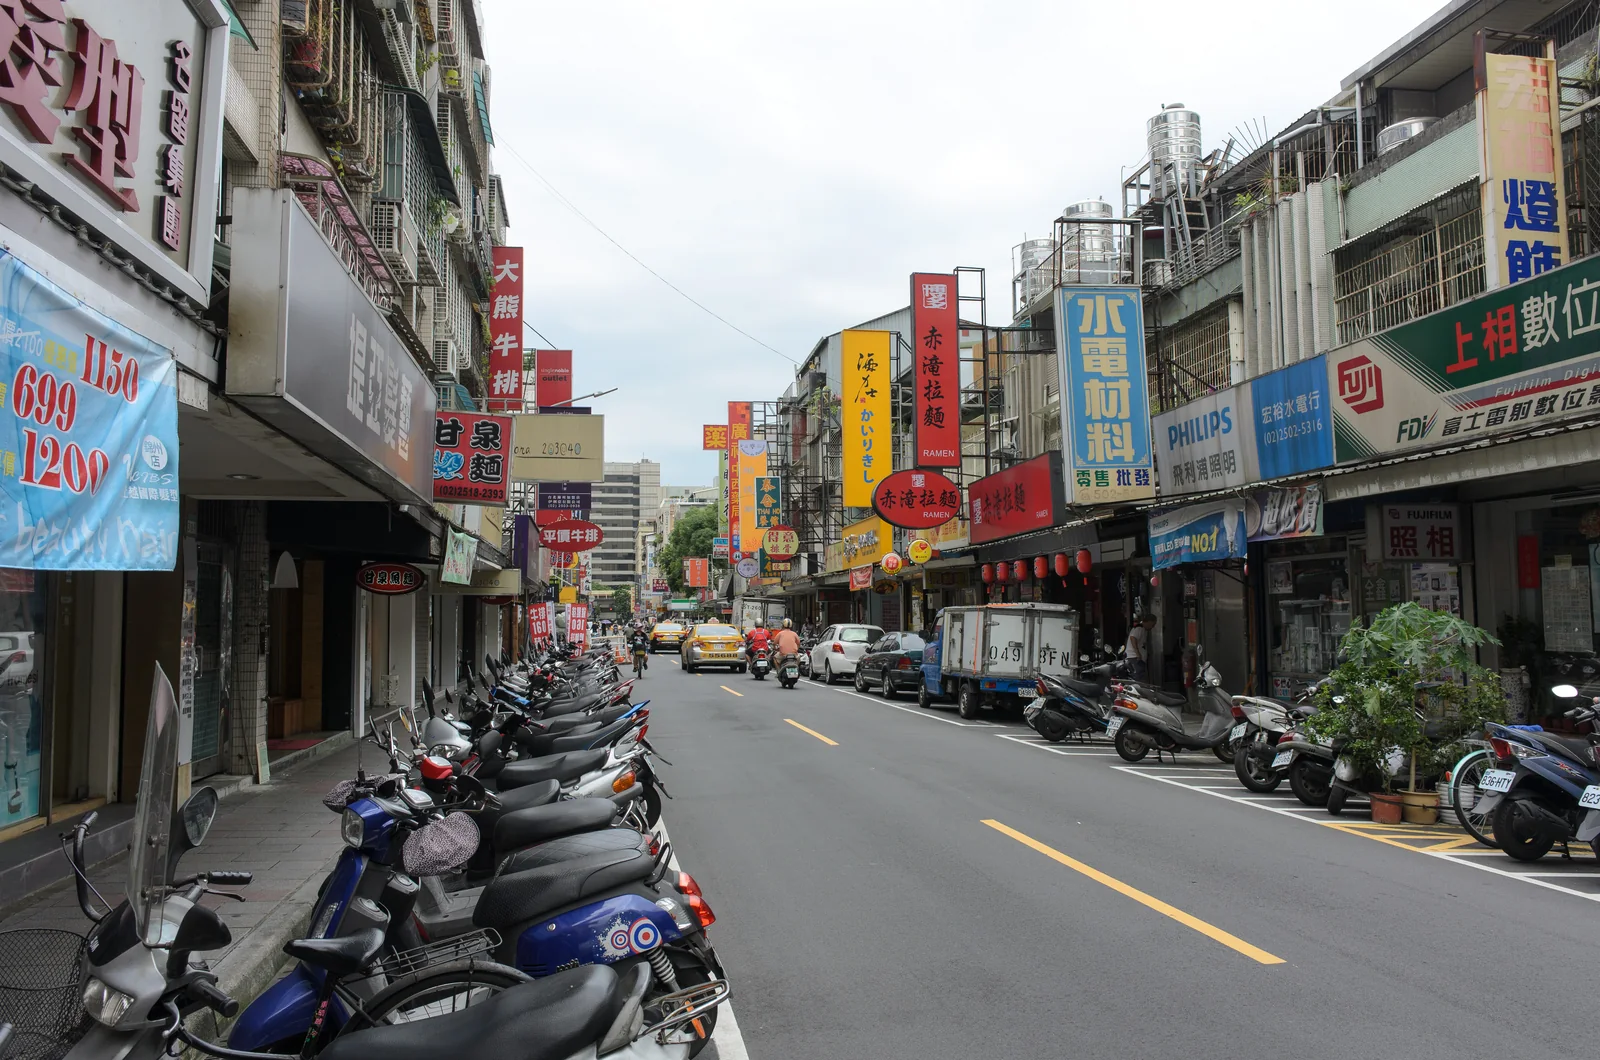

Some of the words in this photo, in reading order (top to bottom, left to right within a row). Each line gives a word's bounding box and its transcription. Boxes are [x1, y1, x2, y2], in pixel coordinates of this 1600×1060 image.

[492, 259, 520, 395] 大熊牛排
[1446, 278, 1600, 374] 上相數位
[80, 333, 140, 403] 1150
[542, 374, 568, 382] outlet
[1077, 295, 1135, 463] 水電材料
[1495, 375, 1552, 398] Fujifilm
[1563, 362, 1600, 381] Digi
[12, 364, 77, 432] 699
[1338, 357, 1380, 411] FUJI
[1261, 390, 1320, 424] 宏裕水電行
[436, 418, 502, 449] 甘泉
[1167, 406, 1232, 451] PHILIPS
[1263, 418, 1323, 446] (02)2502-5316
[20, 427, 110, 496] 1200
[860, 408, 875, 484] かいりきし
[923, 449, 954, 457] RAMEN
[469, 453, 504, 483] 麵
[1076, 470, 1110, 487] 零售
[1116, 469, 1150, 487] 批發
[1172, 450, 1237, 487] 飛利浦照明
[439, 485, 504, 499] (02)2518-2393
[1407, 510, 1452, 519] FUJIFILM
[543, 528, 599, 543] 平價牛排
[1191, 526, 1219, 553] NO.1
[1390, 524, 1454, 557] 照相
[364, 570, 415, 585] 甘泉魚麵
[532, 620, 547, 635] 160
[989, 645, 1021, 662] 049
[1480, 775, 1513, 789] 836-HTY
